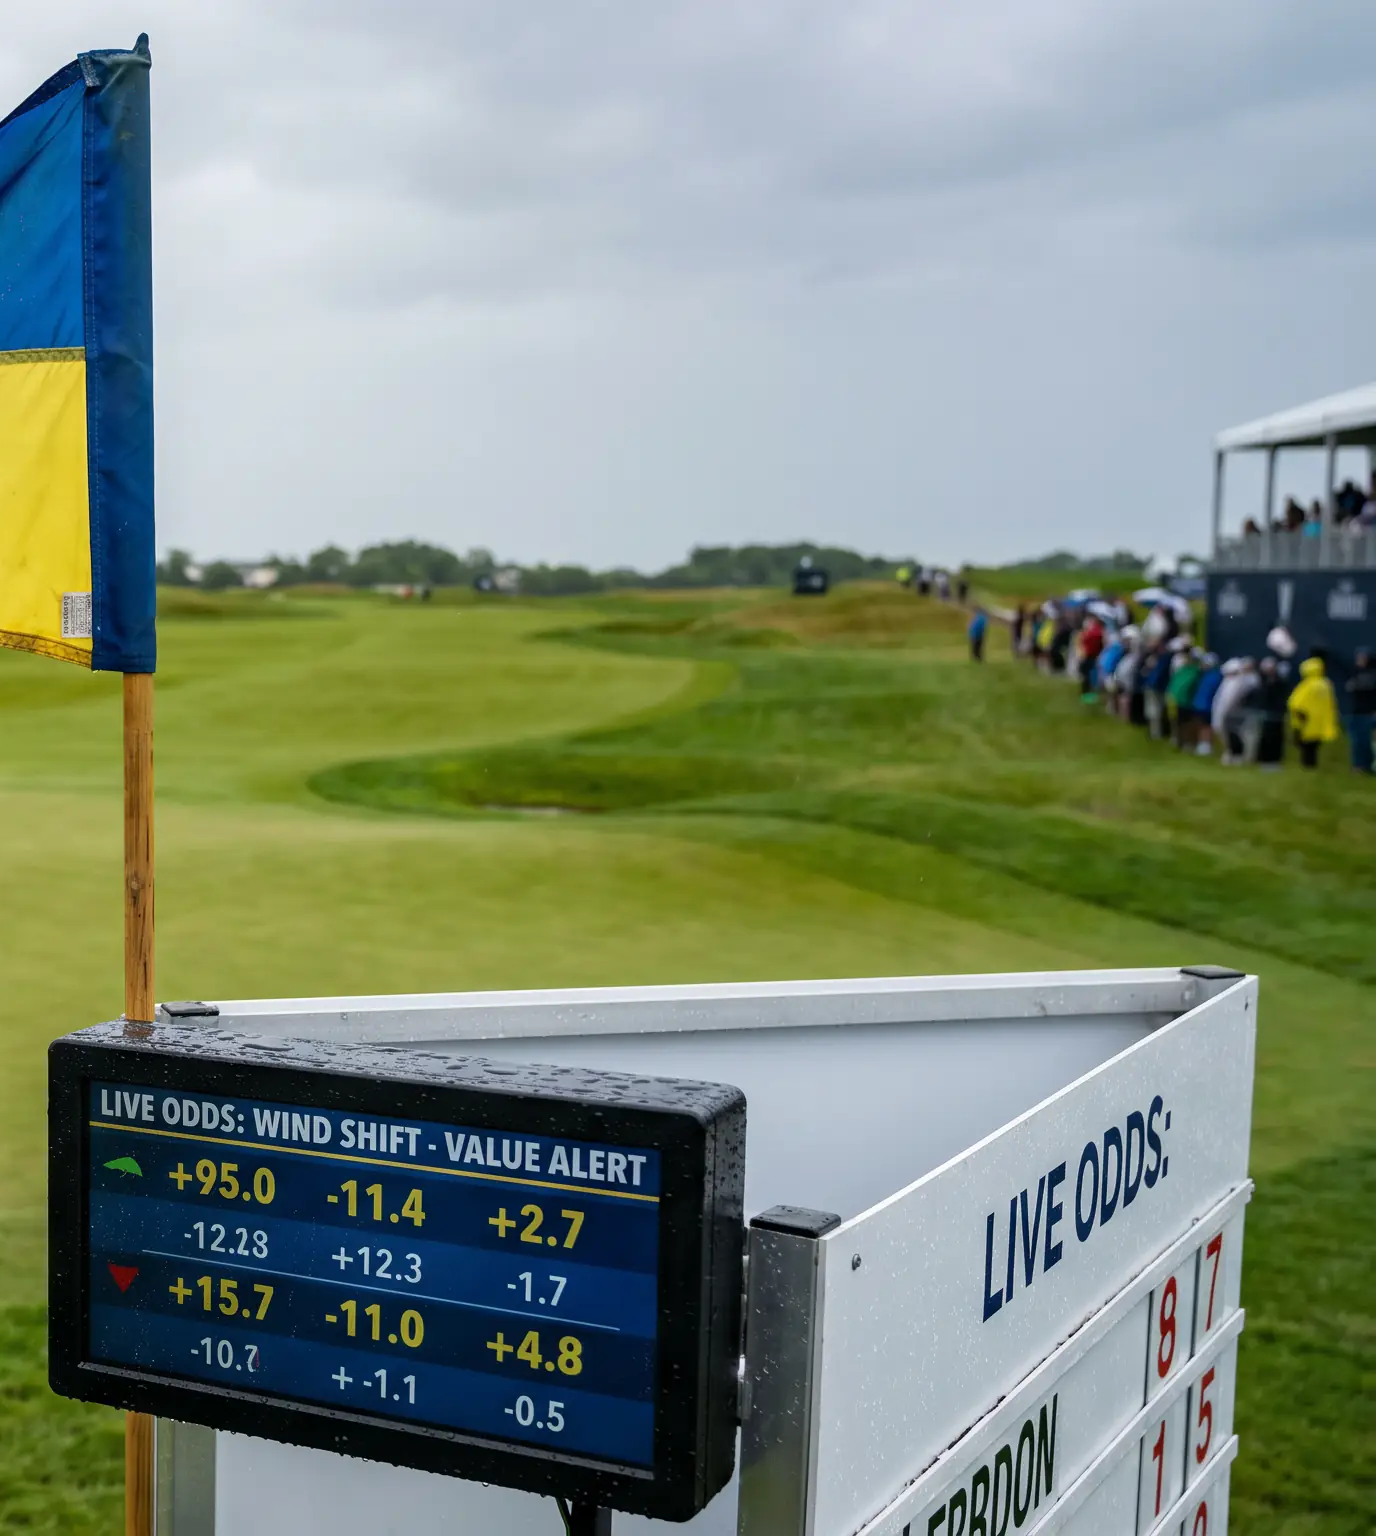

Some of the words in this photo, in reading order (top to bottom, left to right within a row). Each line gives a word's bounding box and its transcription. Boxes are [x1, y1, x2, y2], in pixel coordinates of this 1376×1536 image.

[101, 1089, 154, 1122] LIVE
[162, 1097, 245, 1134] ODDS:
[253, 1107, 332, 1145] WIND
[340, 1118, 421, 1157] SHIFT
[444, 1131, 540, 1173] VALUE
[547, 1145, 647, 1186] ALERT
[169, 1159, 276, 1205] +95.0
[327, 1180, 425, 1227] -11.4
[488, 1204, 585, 1249] +2.7
[982, 1161, 1067, 1324] LIVE
[1075, 1095, 1172, 1243] ODDS:
[331, 1246, 423, 1284] +12.3
[507, 1271, 567, 1307] -1.7
[1158, 1276, 1177, 1378] 8
[1206, 1231, 1223, 1332] 7
[169, 1276, 274, 1321] +15.7
[325, 1300, 424, 1348] -11.0
[486, 1331, 583, 1376] +4.8
[504, 1395, 565, 1432] -0.5
[1153, 1420, 1166, 1518] 1
[1196, 1367, 1215, 1464] 5
